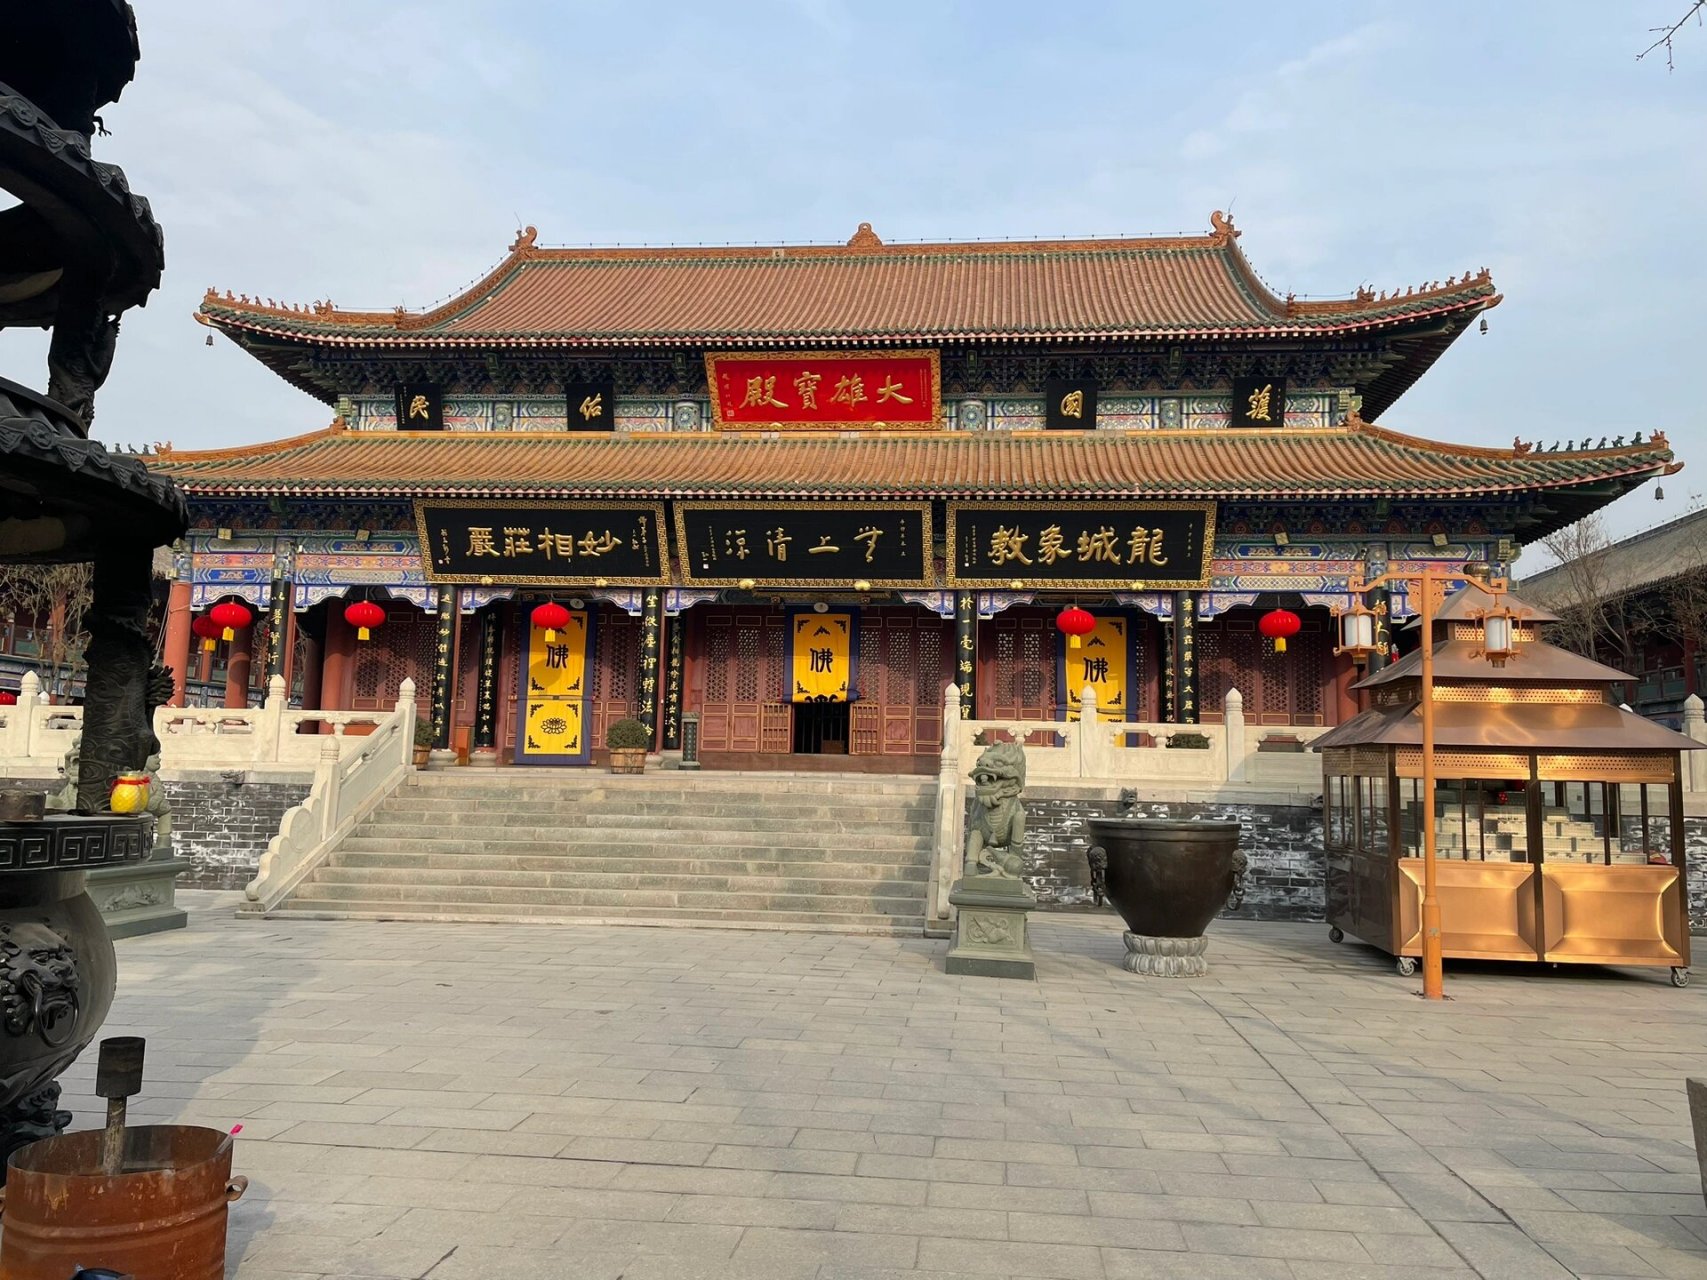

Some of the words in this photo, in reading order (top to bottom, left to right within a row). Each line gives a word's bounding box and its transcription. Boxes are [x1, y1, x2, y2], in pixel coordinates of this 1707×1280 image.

[739, 371, 914, 410] 大雄寶殿
[1060, 390, 1083, 419] 國
[409, 395, 430, 419] 民
[579, 393, 602, 421] 佑
[465, 526, 623, 561] 妙相莊嚴
[987, 523, 1169, 566] 龍城象教
[546, 644, 569, 669] 佛
[810, 648, 833, 673] 佛
[1083, 657, 1109, 683] 佛
